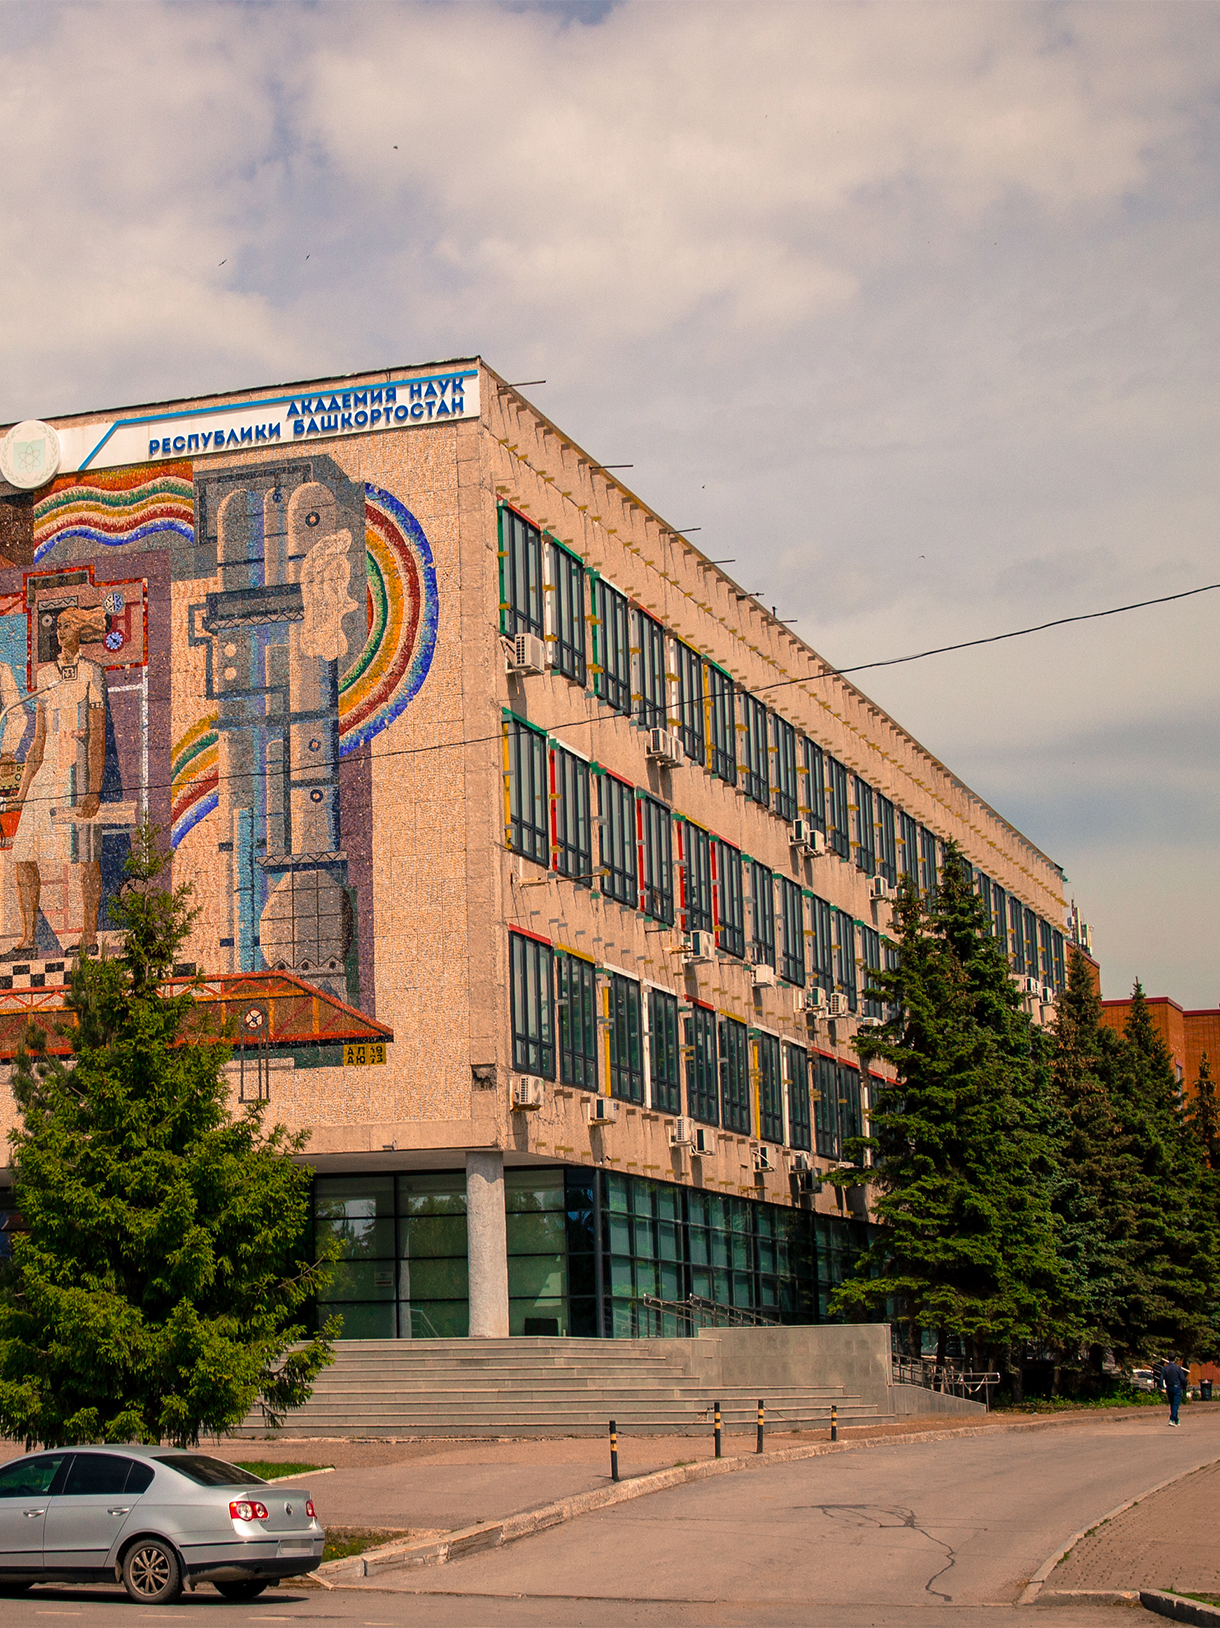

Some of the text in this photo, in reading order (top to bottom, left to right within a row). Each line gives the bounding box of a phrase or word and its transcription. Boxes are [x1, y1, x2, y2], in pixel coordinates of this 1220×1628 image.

[287, 377, 465, 416] АКАДЕМИЯ НАУК
[149, 396, 464, 454] РЕСПУБЛИКИ БАШКОРТОСТАН
